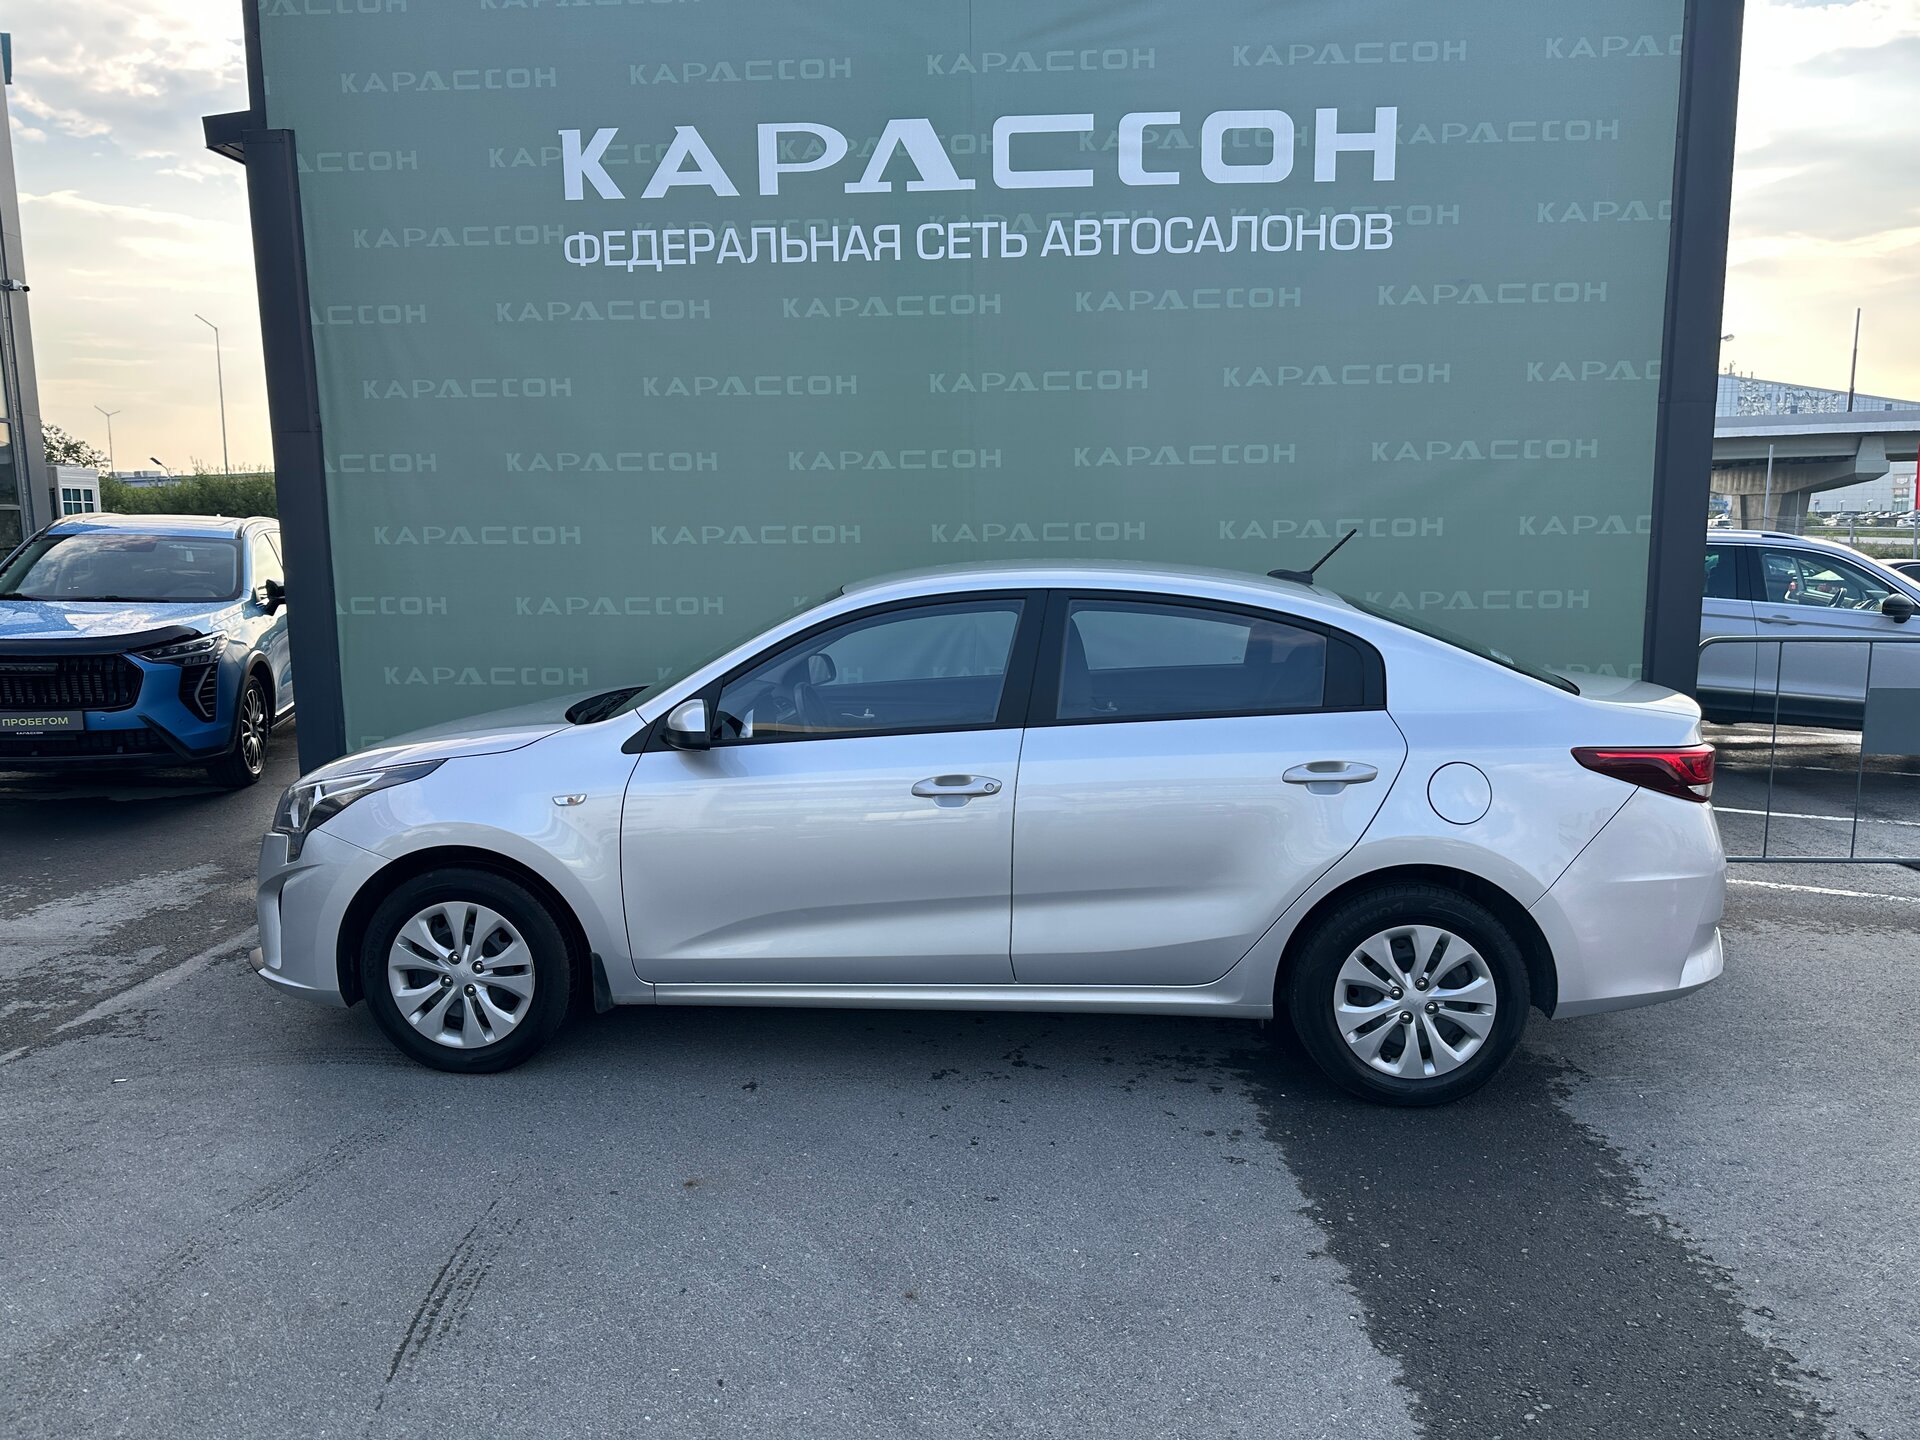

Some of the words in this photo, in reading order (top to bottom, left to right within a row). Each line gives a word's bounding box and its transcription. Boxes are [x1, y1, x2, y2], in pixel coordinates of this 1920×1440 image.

[563, 224, 902, 273] ФЕДЕРАЛЬНАЯ
[916, 221, 1028, 260] СЕТЬ
[1039, 213, 1394, 257] АВТОСАЛОНОВ
[2, 717, 69, 727] ПРОБЕГОМ
